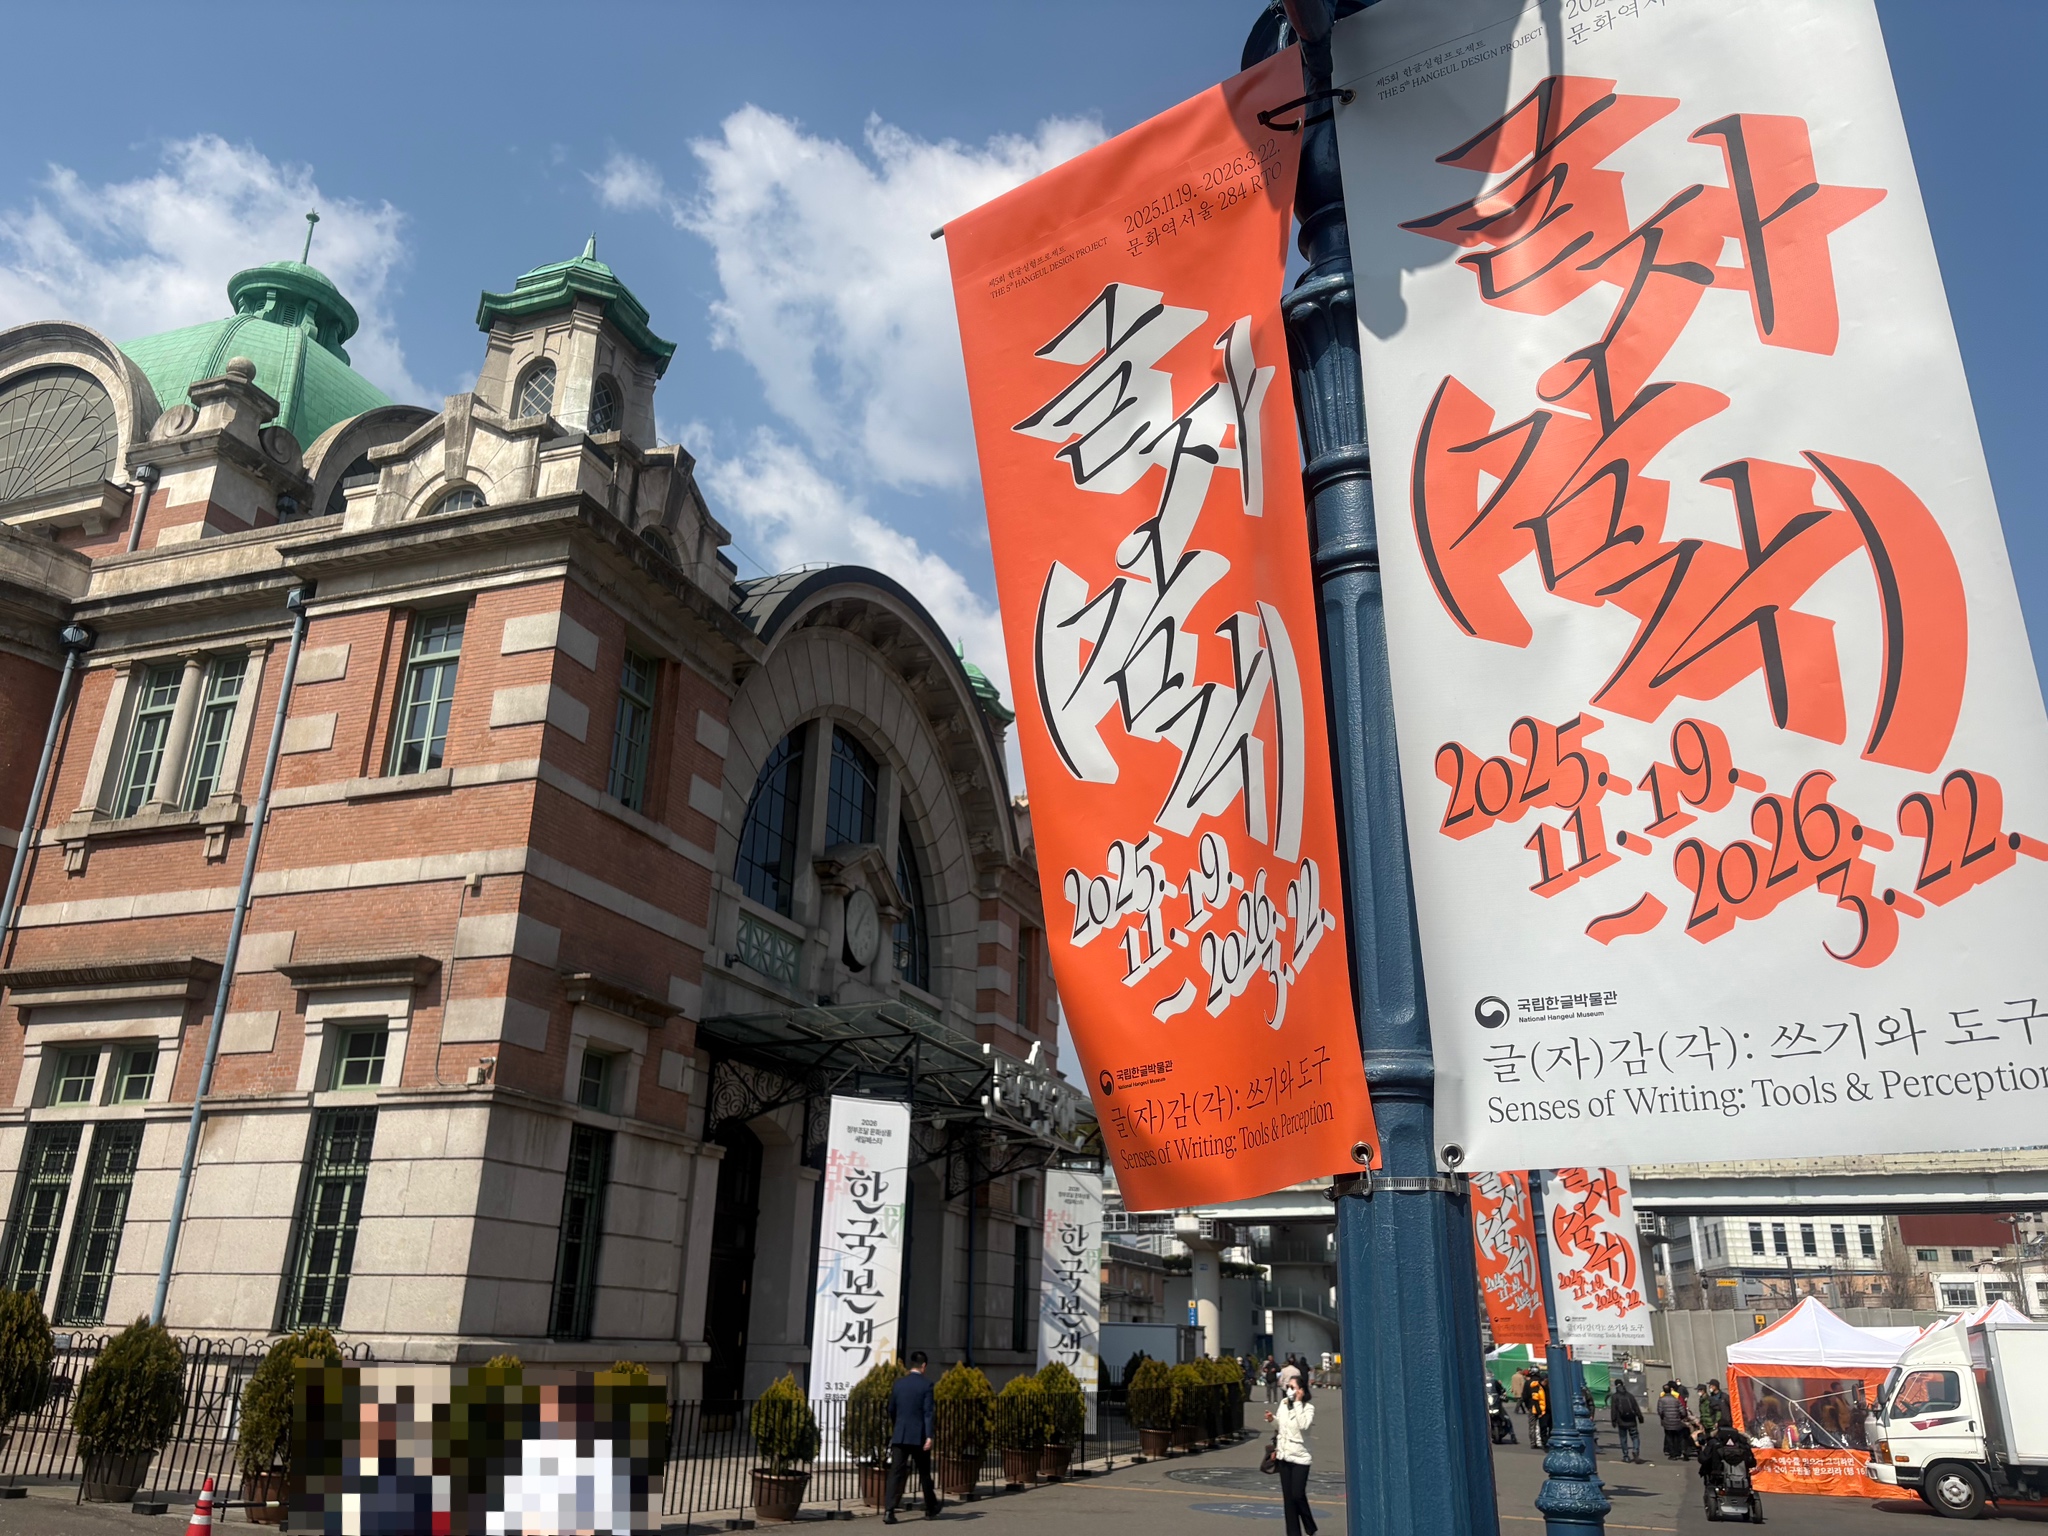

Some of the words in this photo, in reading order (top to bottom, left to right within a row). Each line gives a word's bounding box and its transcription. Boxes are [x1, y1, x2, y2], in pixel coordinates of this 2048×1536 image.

[1377, 86, 1399, 101] THE
[1412, 65, 1460, 88] HANGEUL
[1460, 47, 1499, 69] DESIGN
[1499, 26, 1544, 55] PROJECT
[1126, 200, 1214, 258] 문화역서울
[1217, 181, 1247, 211] 284
[1250, 161, 1282, 195] RTO
[990, 286, 1006, 299] THE
[1014, 267, 1050, 289] HANGEUL
[1049, 253, 1075, 273] DESIGN
[1075, 236, 1108, 259] PROJECT
[1517, 990, 1618, 1012] 국립한글박물관
[1518, 1015, 1546, 1023] National
[1547, 1013, 1575, 1021] Hangeul
[1576, 1010, 1605, 1018] Museum
[1116, 1060, 1173, 1081] 국립한글박물관
[1483, 1024, 1755, 1083] 글(자)감(각):
[1769, 1007, 1928, 1060] 쓰기와
[1944, 998, 2048, 1045] 도구
[1111, 1085, 1241, 1138] 글(자)감(각):
[1246, 1060, 1294, 1110] 쓰기와
[1297, 1045, 1331, 1089] 도구
[1487, 1093, 1581, 1124] Senses
[1588, 1089, 1617, 1118] of
[1623, 1083, 1747, 1117] Writing:
[1750, 1073, 1838, 1109] Tools
[1846, 1072, 1874, 1102] &
[1121, 1147, 1157, 1170] Senses
[1158, 1140, 1171, 1164] of
[1174, 1134, 1238, 1160] Writing:
[1238, 1121, 1270, 1151] Tools
[1271, 1118, 1280, 1140] &
[1280, 1101, 1335, 1139] Perception
